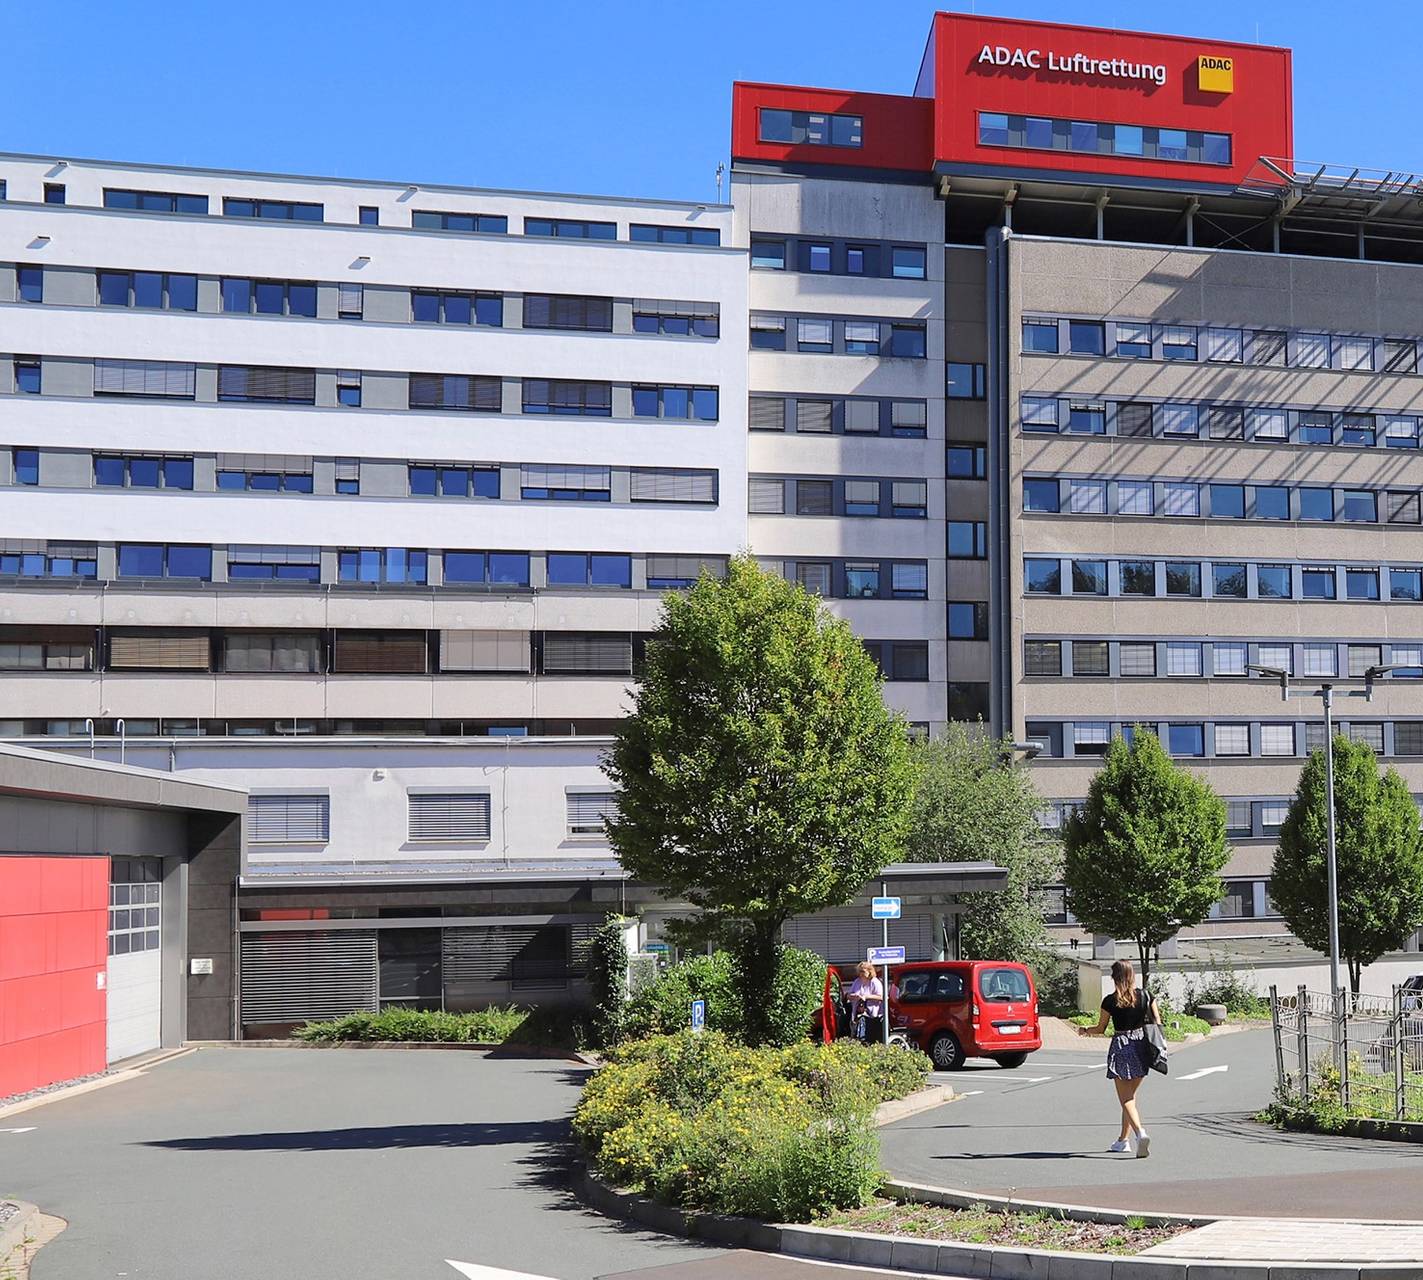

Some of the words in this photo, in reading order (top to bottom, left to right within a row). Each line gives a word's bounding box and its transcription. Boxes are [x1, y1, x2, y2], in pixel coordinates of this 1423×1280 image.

[978, 45, 1041, 68] ADAC
[1048, 51, 1166, 86] Luftrettung
[1200, 57, 1232, 71] ADAC
[869, 949, 877, 961] P
[695, 1004, 702, 1025] P
